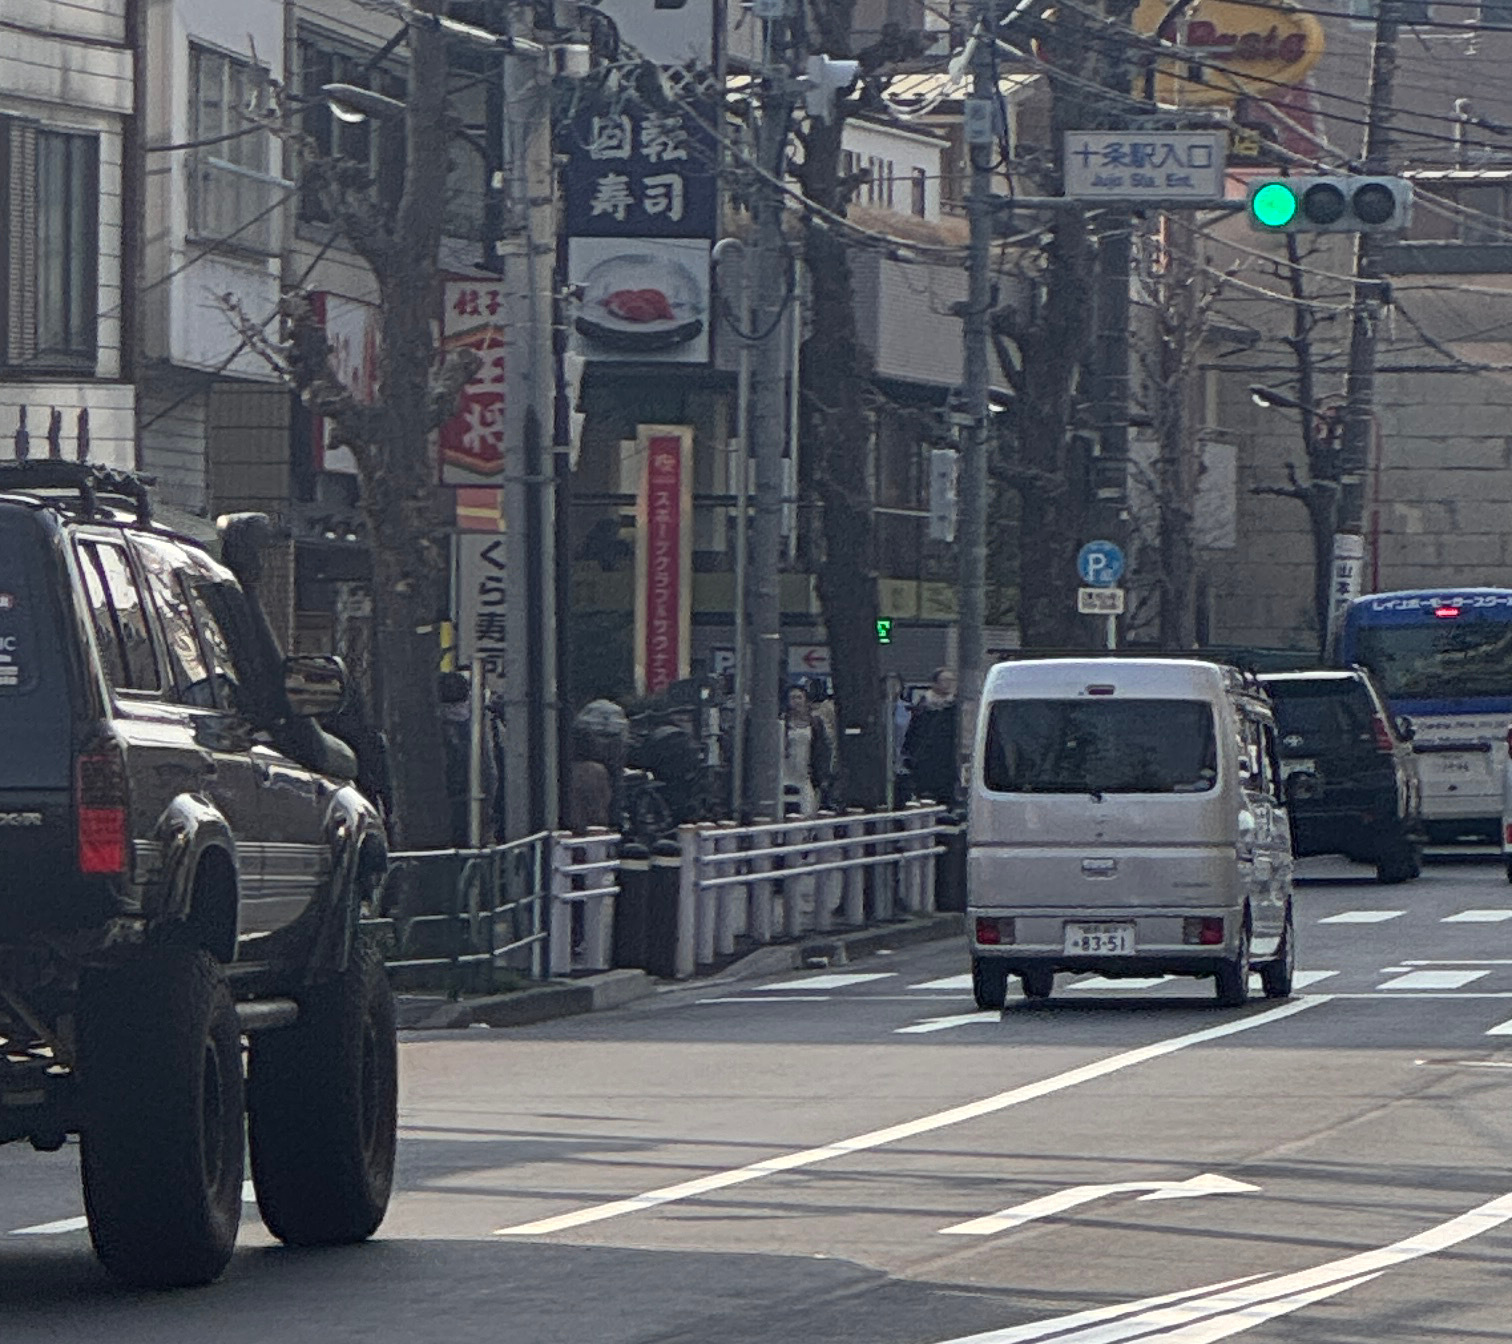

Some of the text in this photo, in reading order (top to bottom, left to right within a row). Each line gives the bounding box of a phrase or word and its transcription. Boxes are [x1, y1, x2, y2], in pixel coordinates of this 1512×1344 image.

[590, 114, 688, 163] 回転
[1072, 142, 1213, 169] 十条駅入口
[590, 172, 684, 222] 寿司
[453, 289, 504, 316] 餃子
[463, 346, 505, 454] 王将
[474, 539, 506, 679] くら寿司
